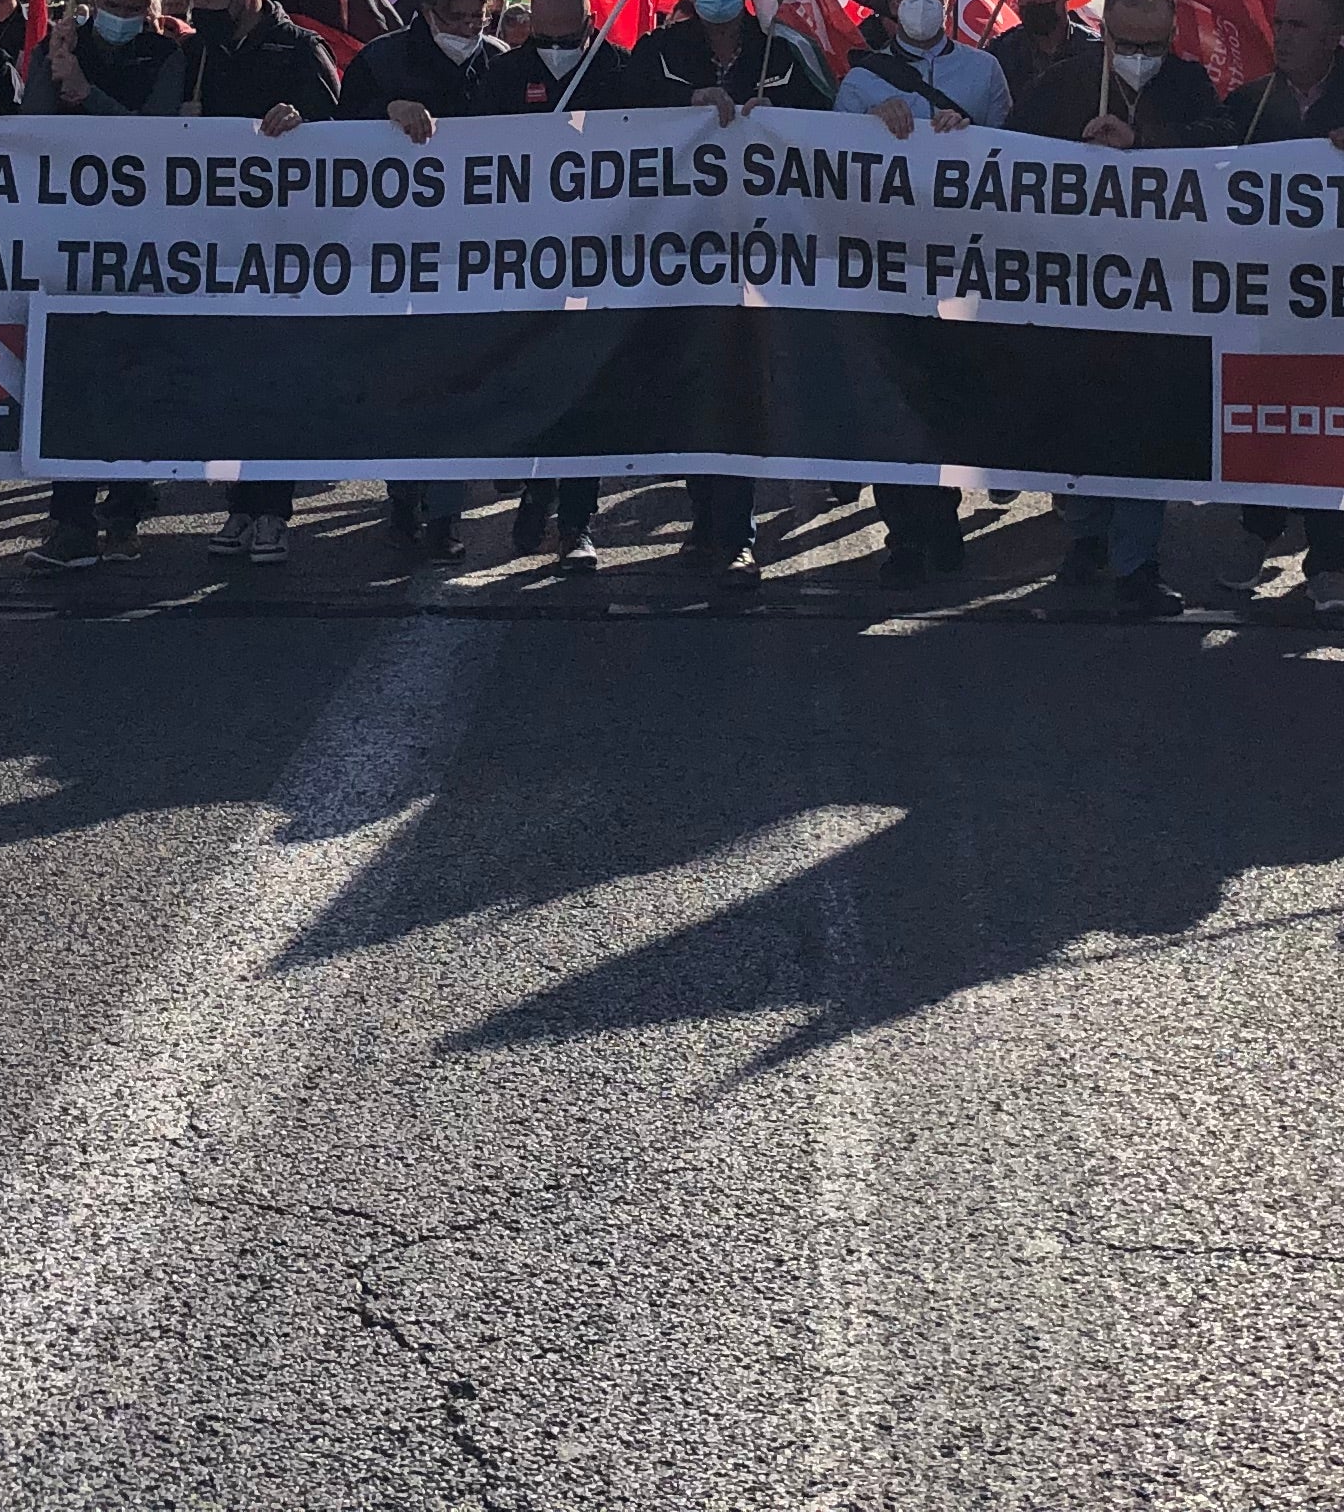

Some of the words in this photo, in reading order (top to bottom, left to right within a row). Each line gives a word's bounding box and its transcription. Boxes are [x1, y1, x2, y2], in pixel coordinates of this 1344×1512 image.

[38, 154, 147, 207] LOS
[166, 156, 446, 209] DESPIDOS
[463, 153, 531, 206] EN
[550, 144, 728, 203] GDELS
[742, 143, 915, 206] SANTA
[933, 148, 1207, 223] BÁRBARA
[58, 240, 351, 296] TRASLADO
[371, 241, 440, 294] DE
[458, 218, 817, 292] PRODUCCIÓN
[837, 236, 907, 294] DE
[926, 233, 1173, 311] FÁBRICA
[1192, 260, 1269, 316] DE
